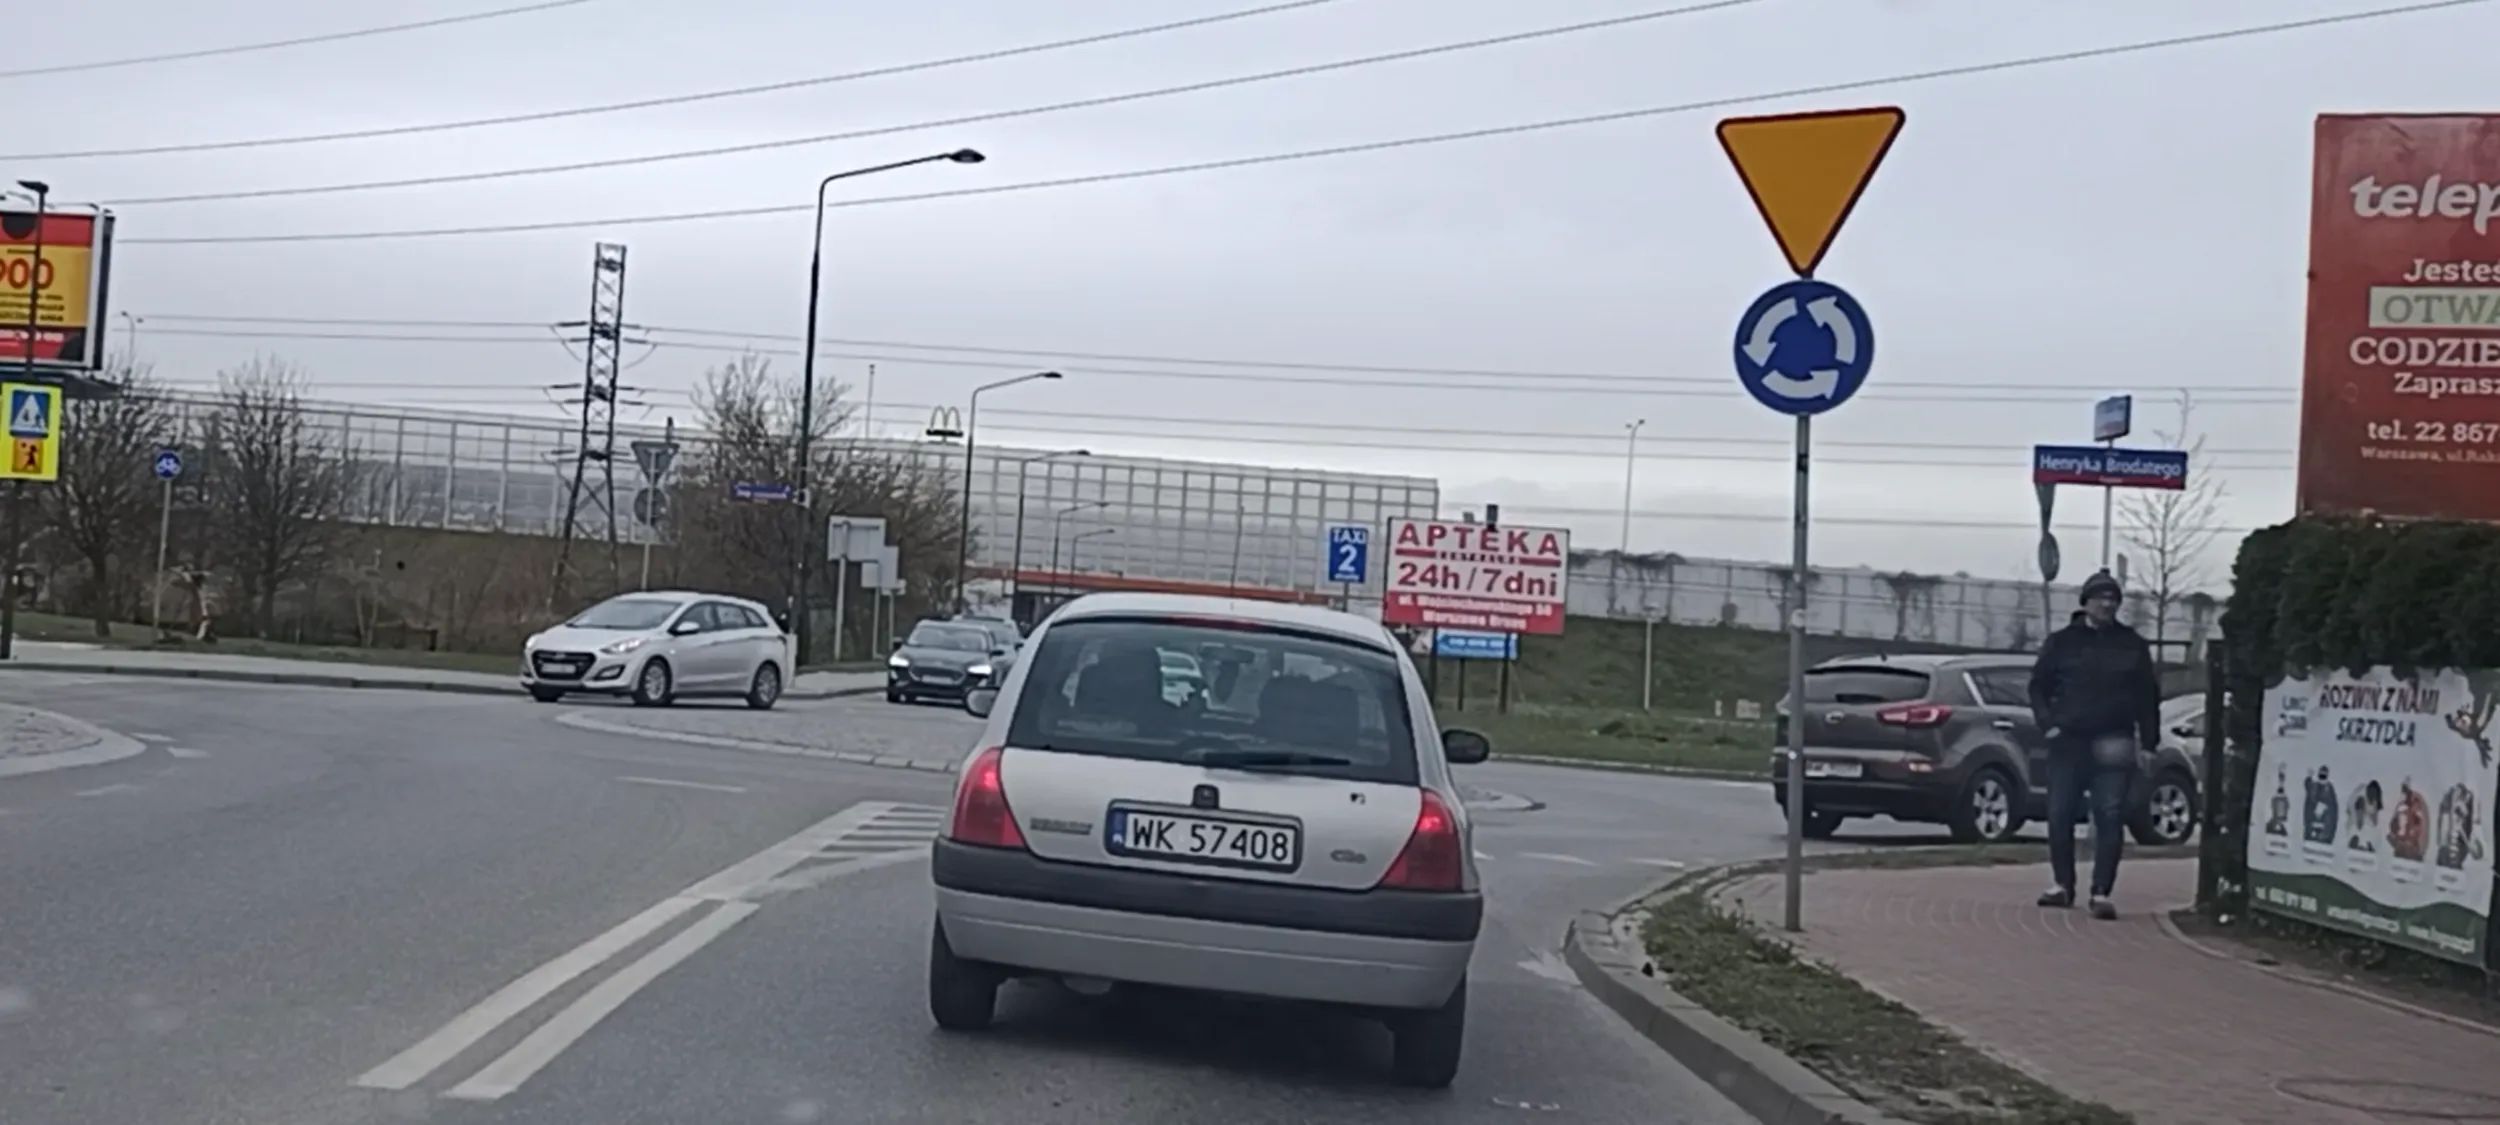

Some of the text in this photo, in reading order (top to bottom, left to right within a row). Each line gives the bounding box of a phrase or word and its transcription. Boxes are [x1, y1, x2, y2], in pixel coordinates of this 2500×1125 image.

[0, 257, 54, 290] 00
[2414, 421, 2446, 441] 22
[2040, 454, 2101, 475] Henryka
[2105, 457, 2181, 480] Brodatego
[1332, 528, 1366, 544] TAXI
[1397, 522, 1561, 556] APTEKA
[1337, 545, 1360, 574] 2
[2336, 716, 2416, 746] SKRZYDŁA
[1131, 817, 1176, 851] WK
[1188, 825, 1289, 862] 57408
